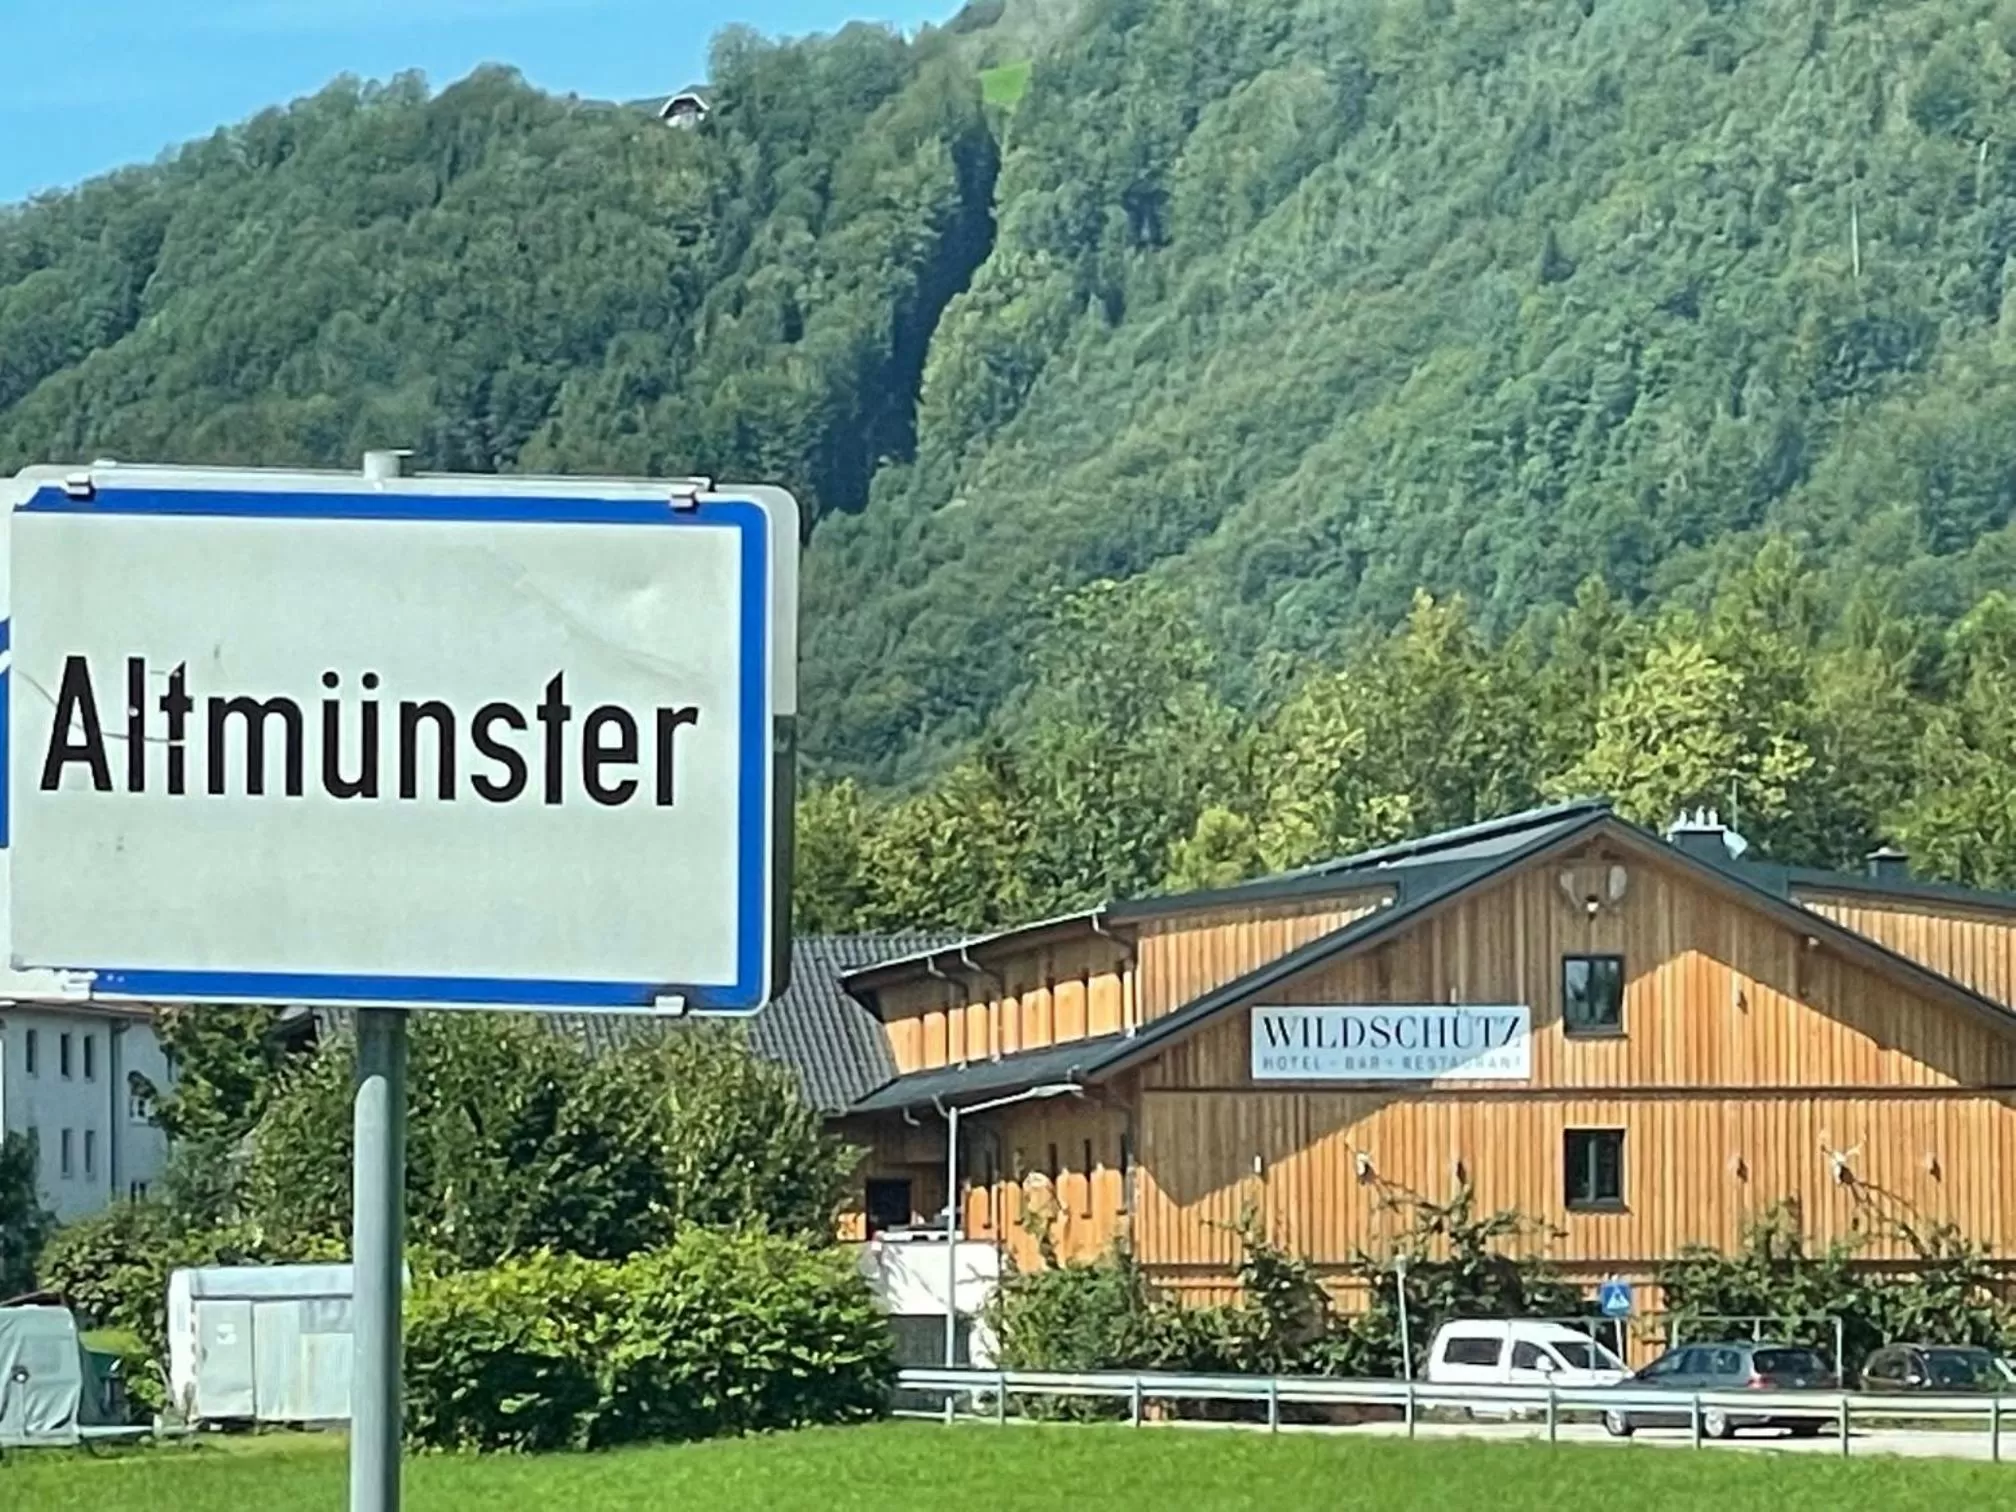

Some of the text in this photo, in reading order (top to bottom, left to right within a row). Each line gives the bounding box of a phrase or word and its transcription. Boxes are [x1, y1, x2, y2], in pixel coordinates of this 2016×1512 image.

[40, 655, 699, 806] Altmünster
[1263, 1010, 1520, 1049] WILDSCHÜTZ
[1263, 1056, 1320, 1071] HOTEL
[1345, 1056, 1381, 1071] BAR
